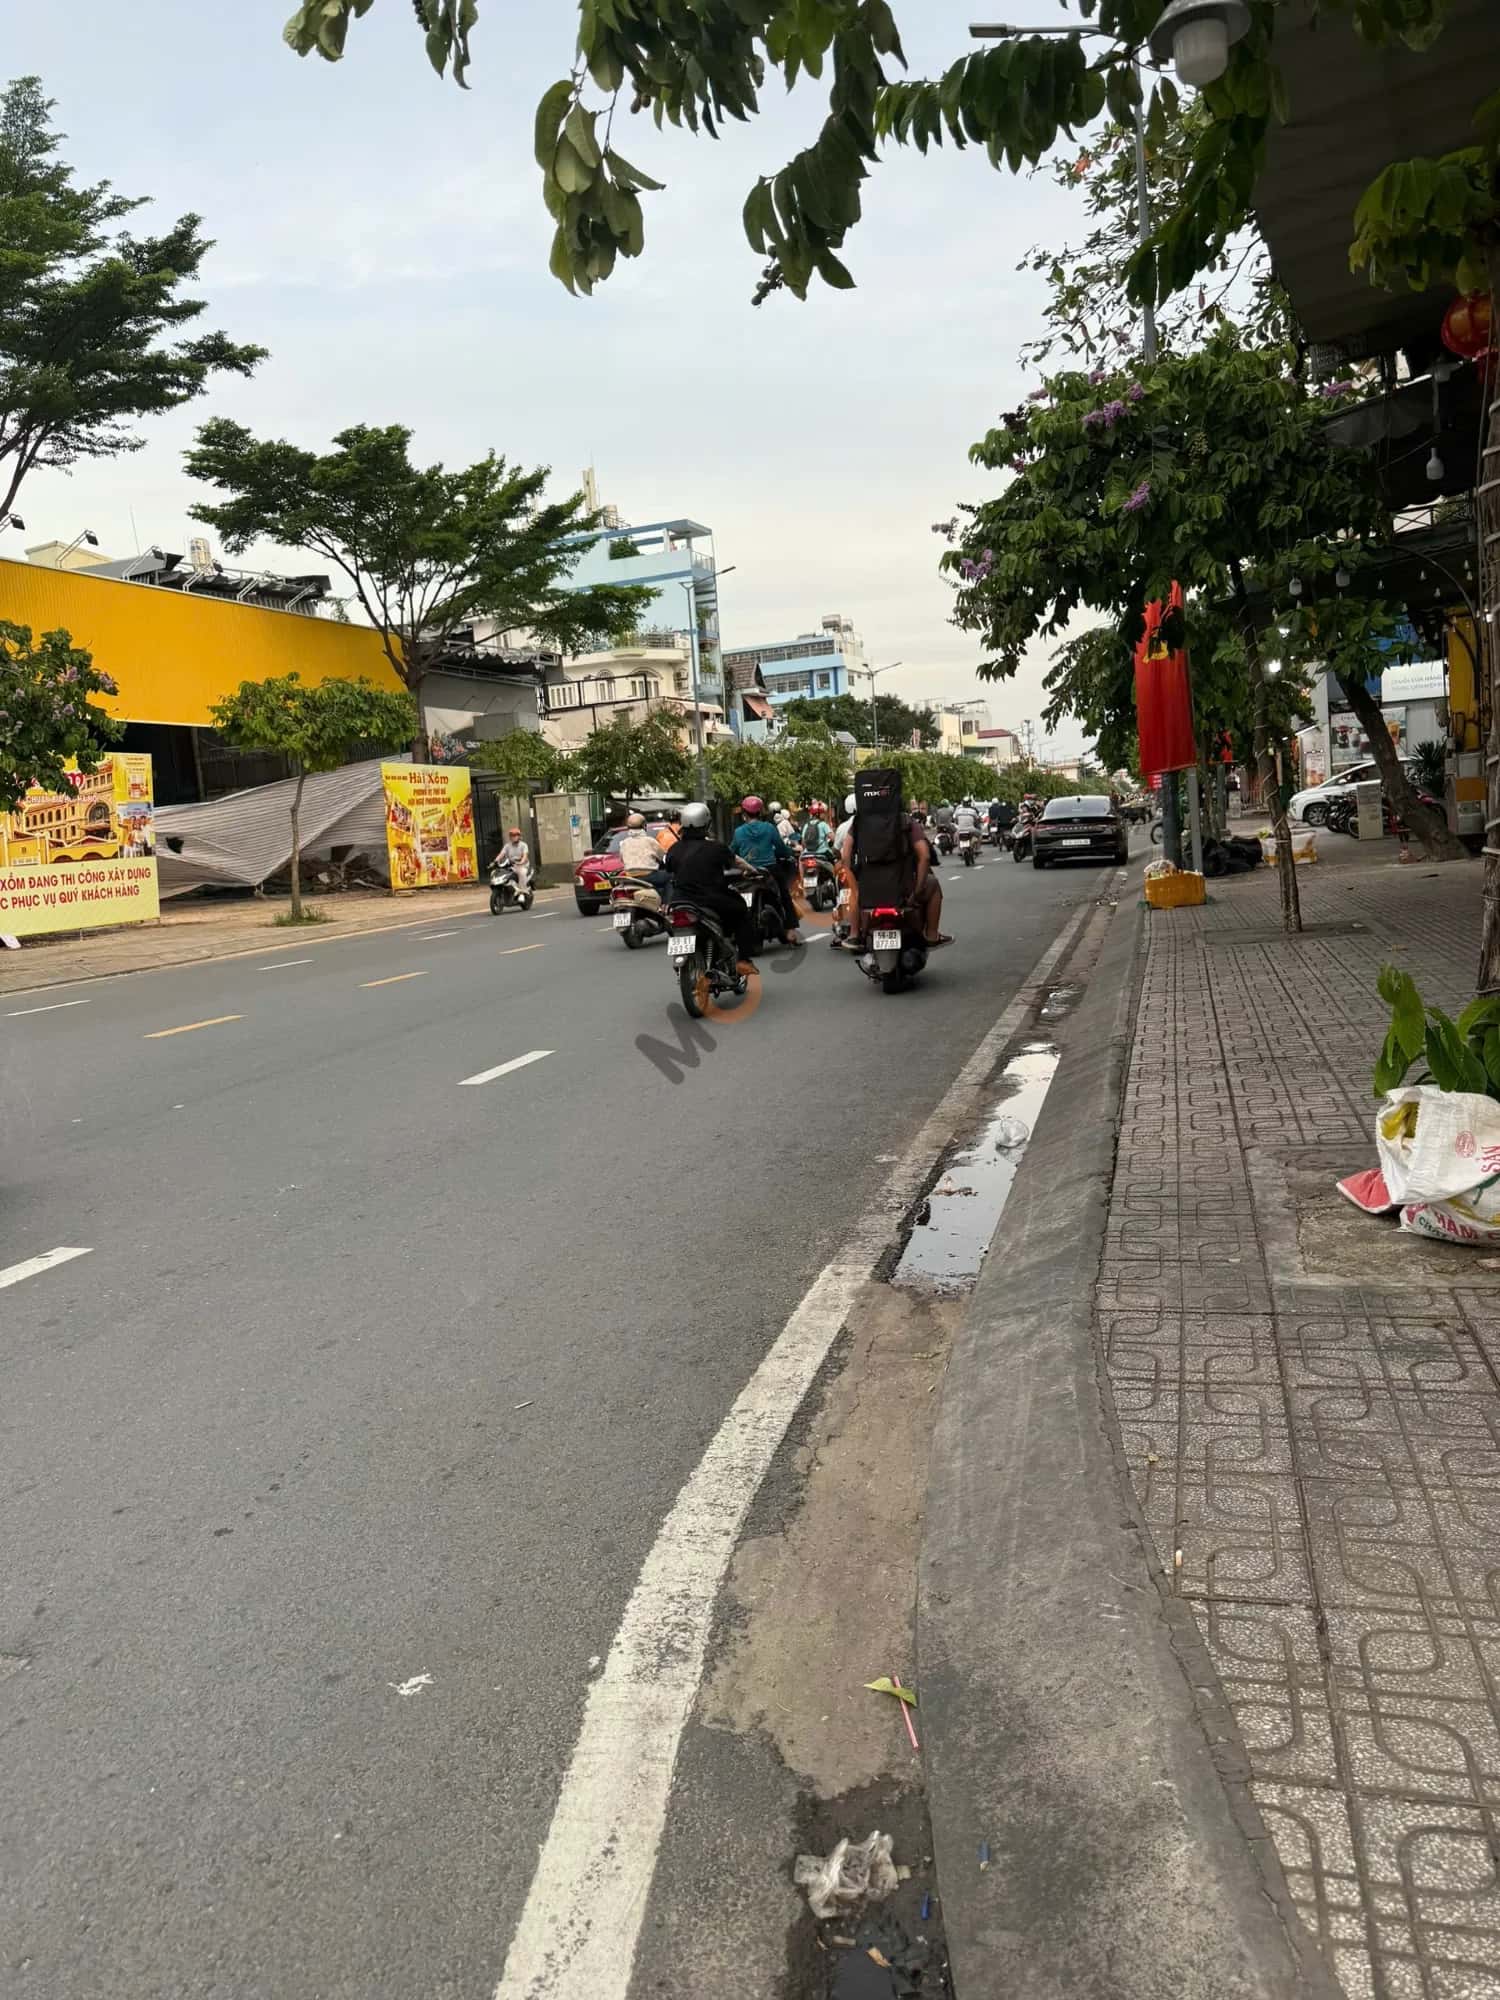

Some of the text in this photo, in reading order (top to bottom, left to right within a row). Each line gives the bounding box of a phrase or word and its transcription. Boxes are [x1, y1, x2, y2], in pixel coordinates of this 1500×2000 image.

[28, 874, 58, 889] ĐANG
[61, 872, 75, 885] THI
[78, 869, 105, 884] CÔNG
[108, 866, 125, 881] XÂY
[127, 867, 151, 883] DỰNG
[11, 894, 40, 911] PHỤC
[43, 892, 56, 908] VỤ
[59, 887, 78, 903] QUÝ
[81, 885, 112, 901] KHÁCH
[115, 882, 140, 898] HÀNG
